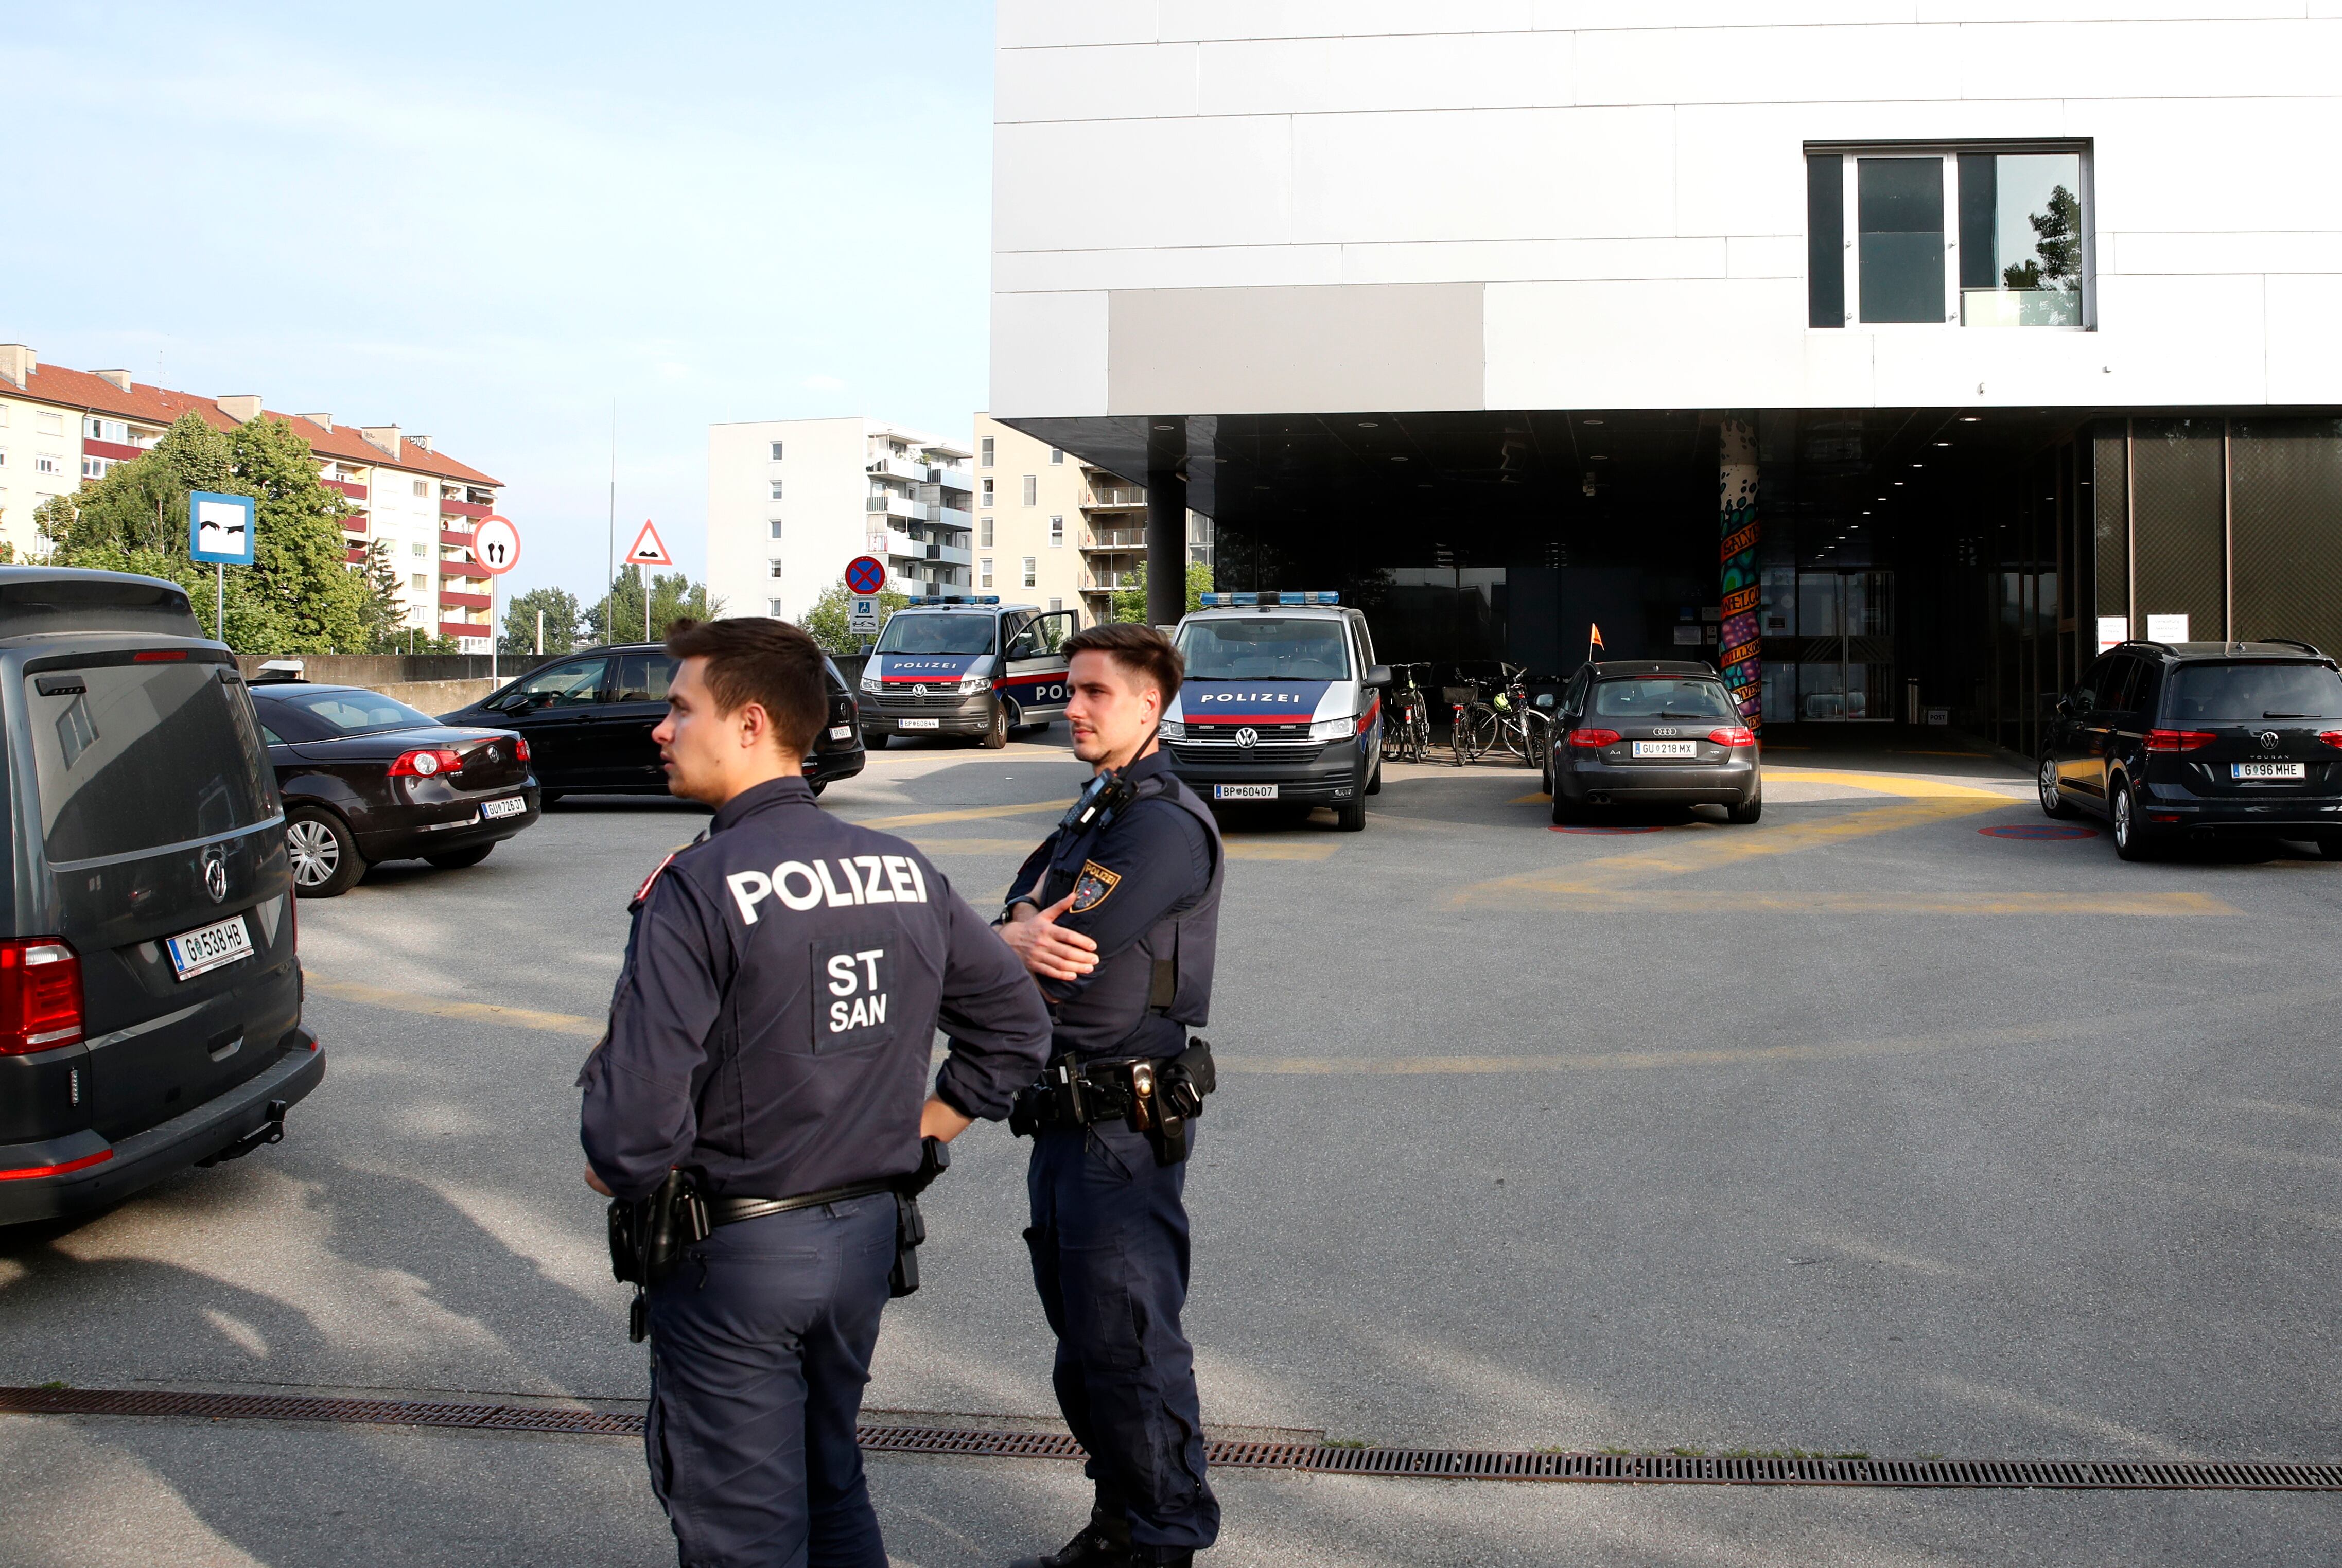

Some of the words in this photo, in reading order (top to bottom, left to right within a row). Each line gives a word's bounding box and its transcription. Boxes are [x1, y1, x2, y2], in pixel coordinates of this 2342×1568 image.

[1201, 693, 1299, 703] POLIZEI
[726, 855, 928, 925] POLIZEI
[1085, 864, 1116, 885] POLIZEI
[827, 949, 884, 996] ST
[829, 993, 887, 1033] SAN
